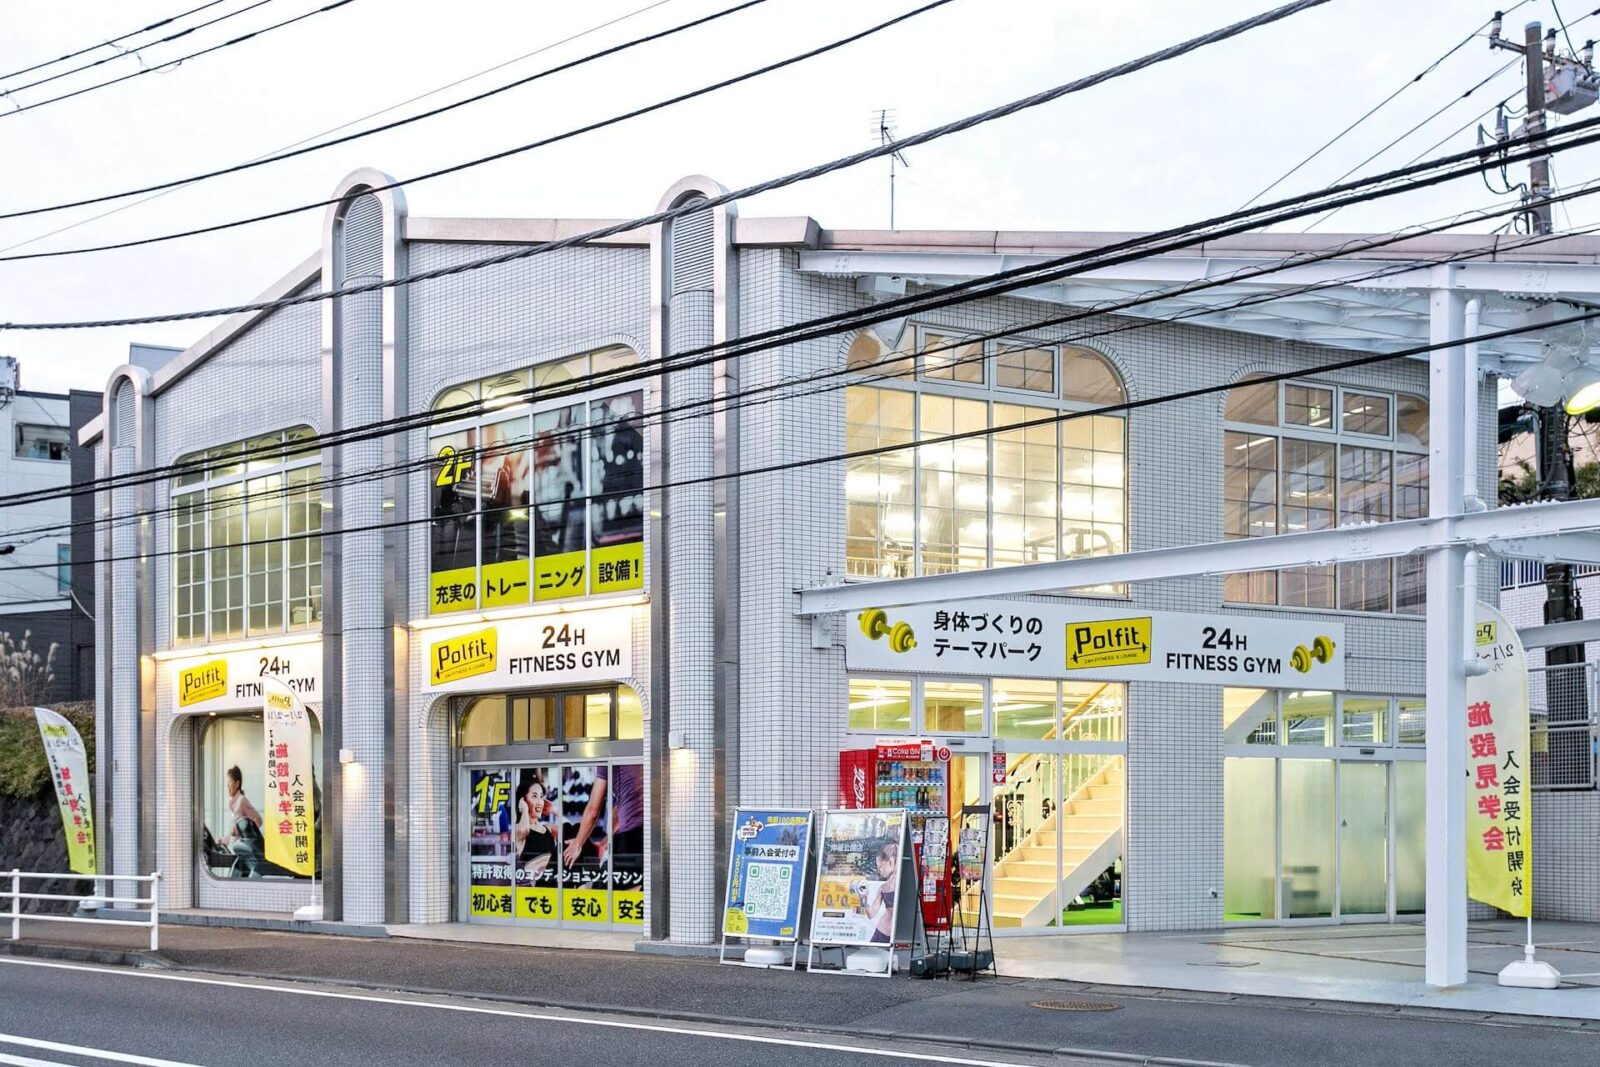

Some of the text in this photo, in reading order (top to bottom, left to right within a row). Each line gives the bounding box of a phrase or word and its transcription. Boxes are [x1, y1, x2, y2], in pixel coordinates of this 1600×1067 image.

[436, 446, 475, 487] 2F
[933, 610, 1042, 636] 身体づくりの
[542, 624, 585, 649] 24H
[1075, 626, 1140, 654] Polfit
[1202, 627, 1247, 651] 24H
[438, 638, 487, 670] Polfit
[509, 649, 620, 675] FITNESS GYM
[933, 639, 1042, 663] テーマパーク
[1166, 652, 1281, 674] FITNESS GYM
[259, 656, 290, 677] 24H
[184, 667, 220, 694] Polfit
[236, 682, 264, 698] FITN
[473, 775, 511, 813] 1F
